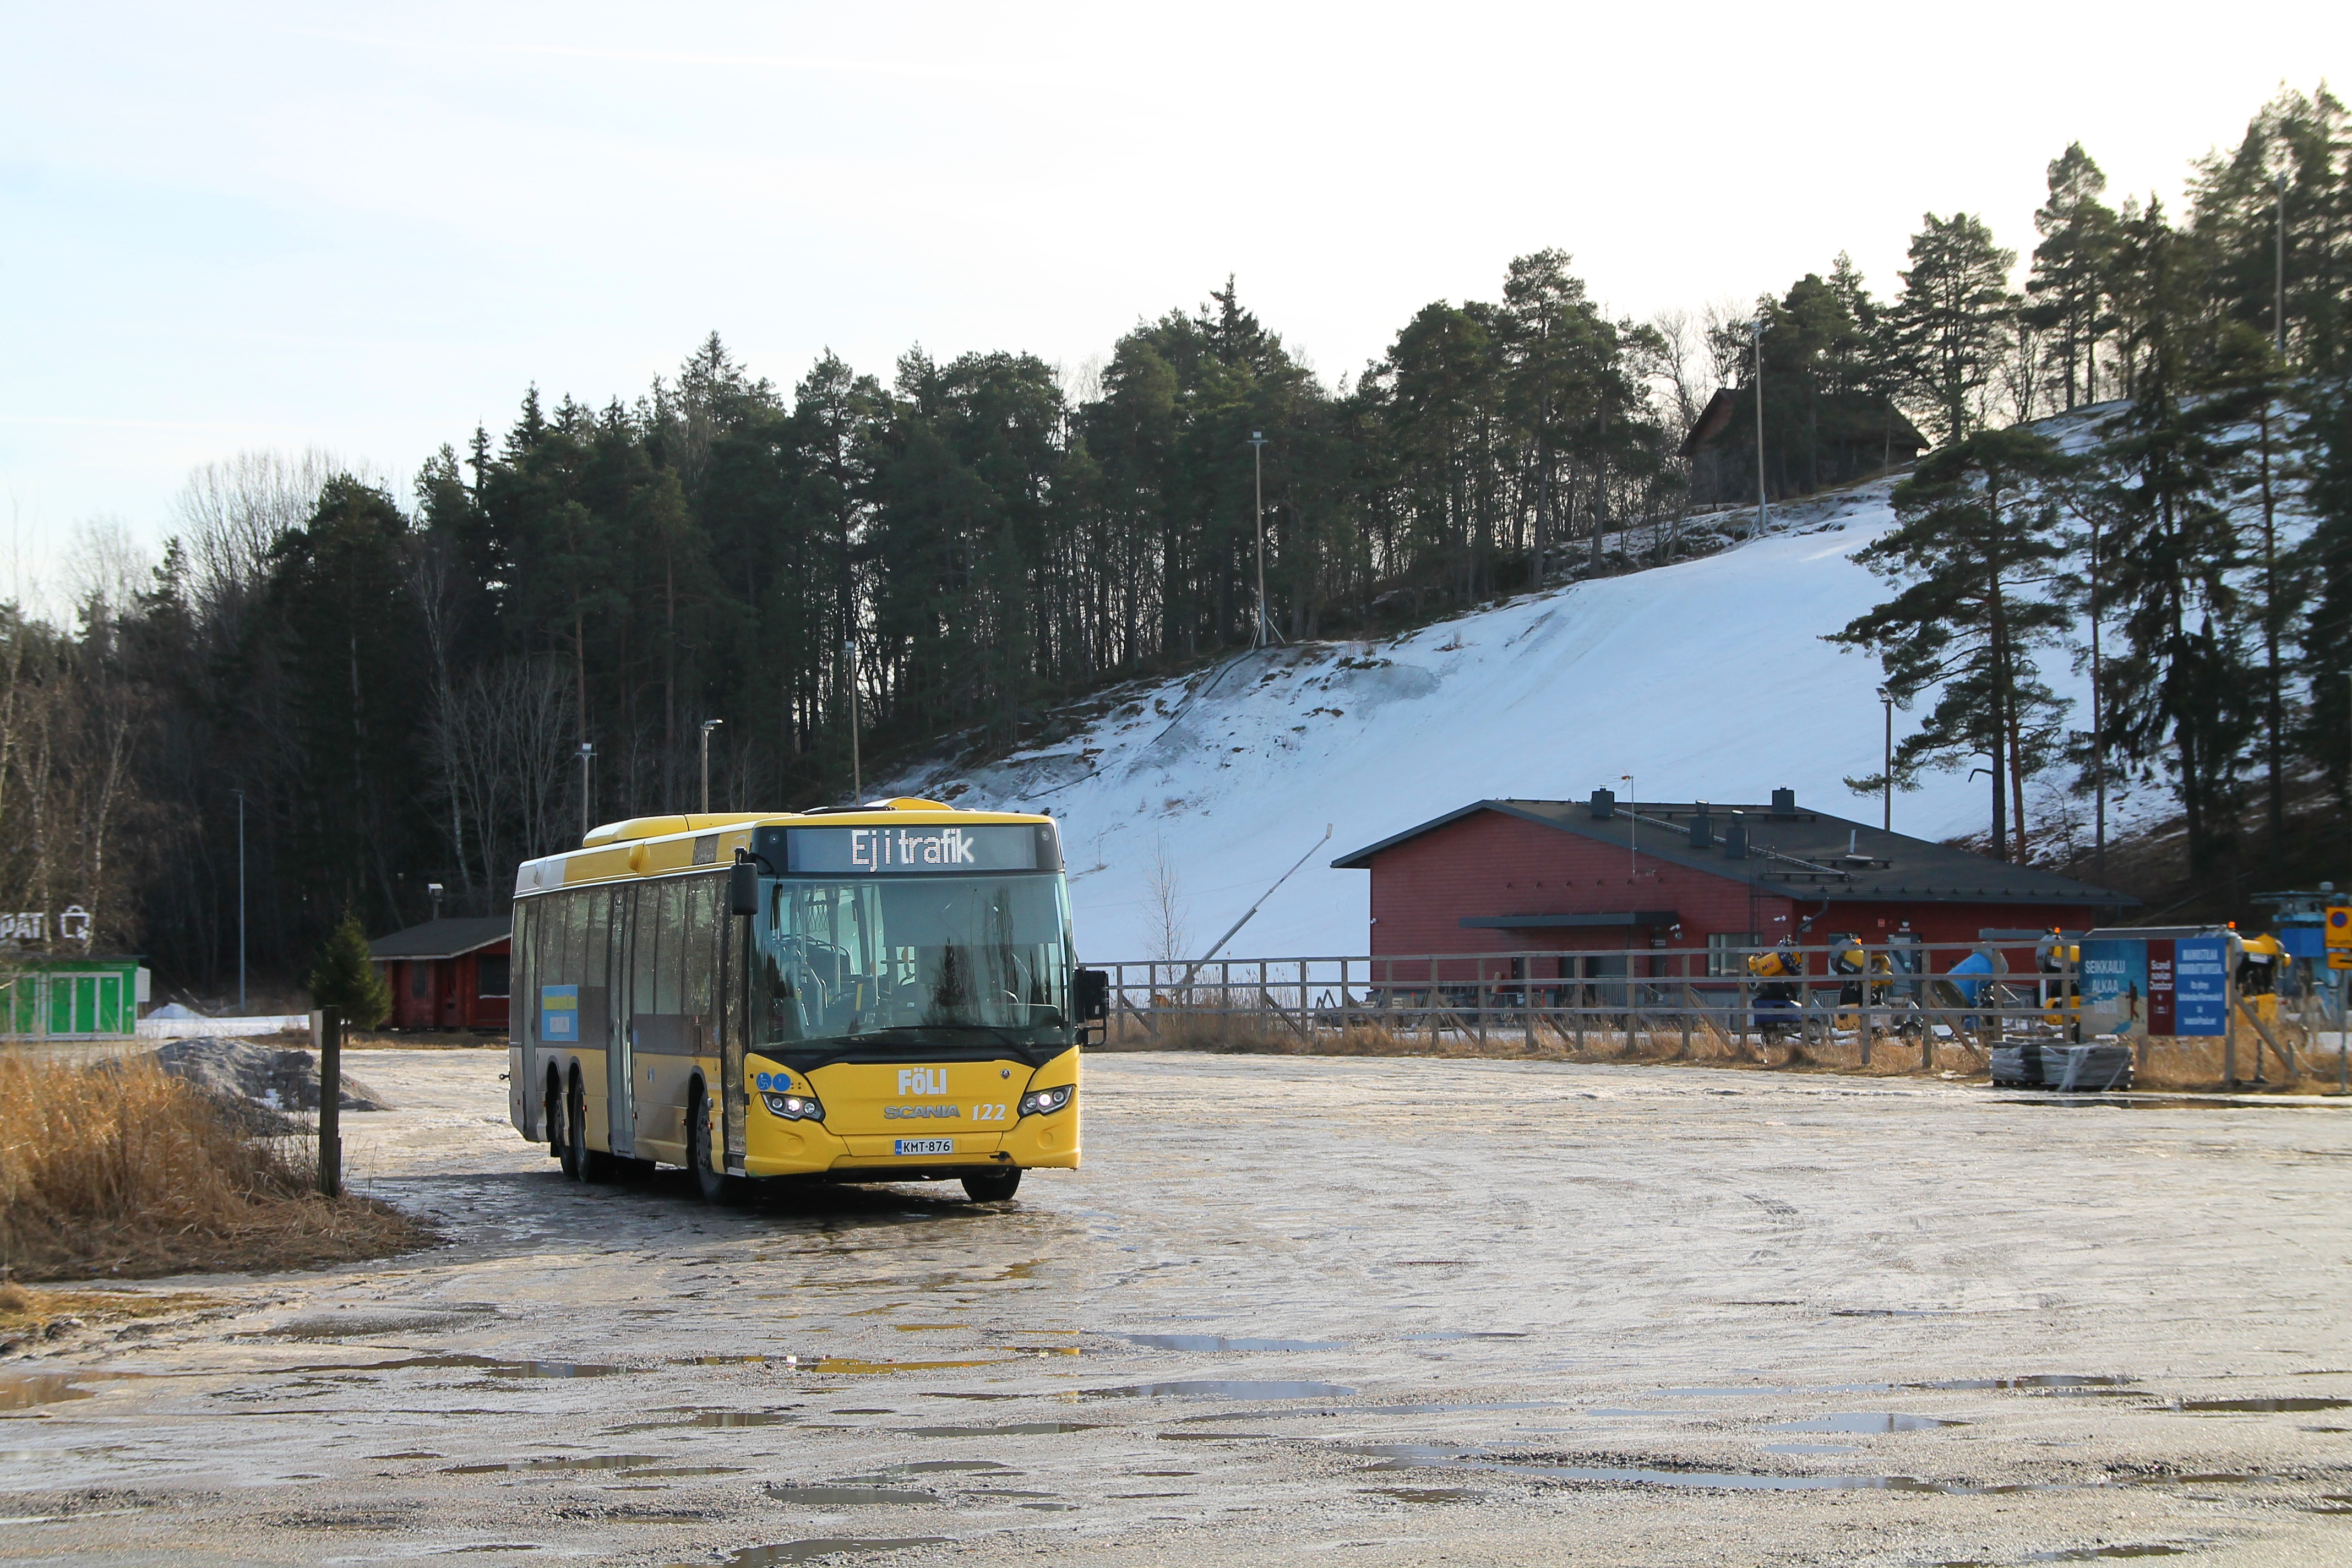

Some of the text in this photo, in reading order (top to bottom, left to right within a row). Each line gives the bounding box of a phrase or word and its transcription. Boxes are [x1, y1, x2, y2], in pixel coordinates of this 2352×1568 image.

[852, 830, 878, 872] Ej
[898, 829, 974, 864] trafik
[2085, 960, 2126, 974] SEIKKAILU
[2150, 960, 2171, 970] Scandi
[2092, 979, 2119, 993] ALKAA
[884, 1104, 961, 1119] SCANIA
[972, 1103, 1006, 1120] 122
[903, 1141, 950, 1153] KMT-876
